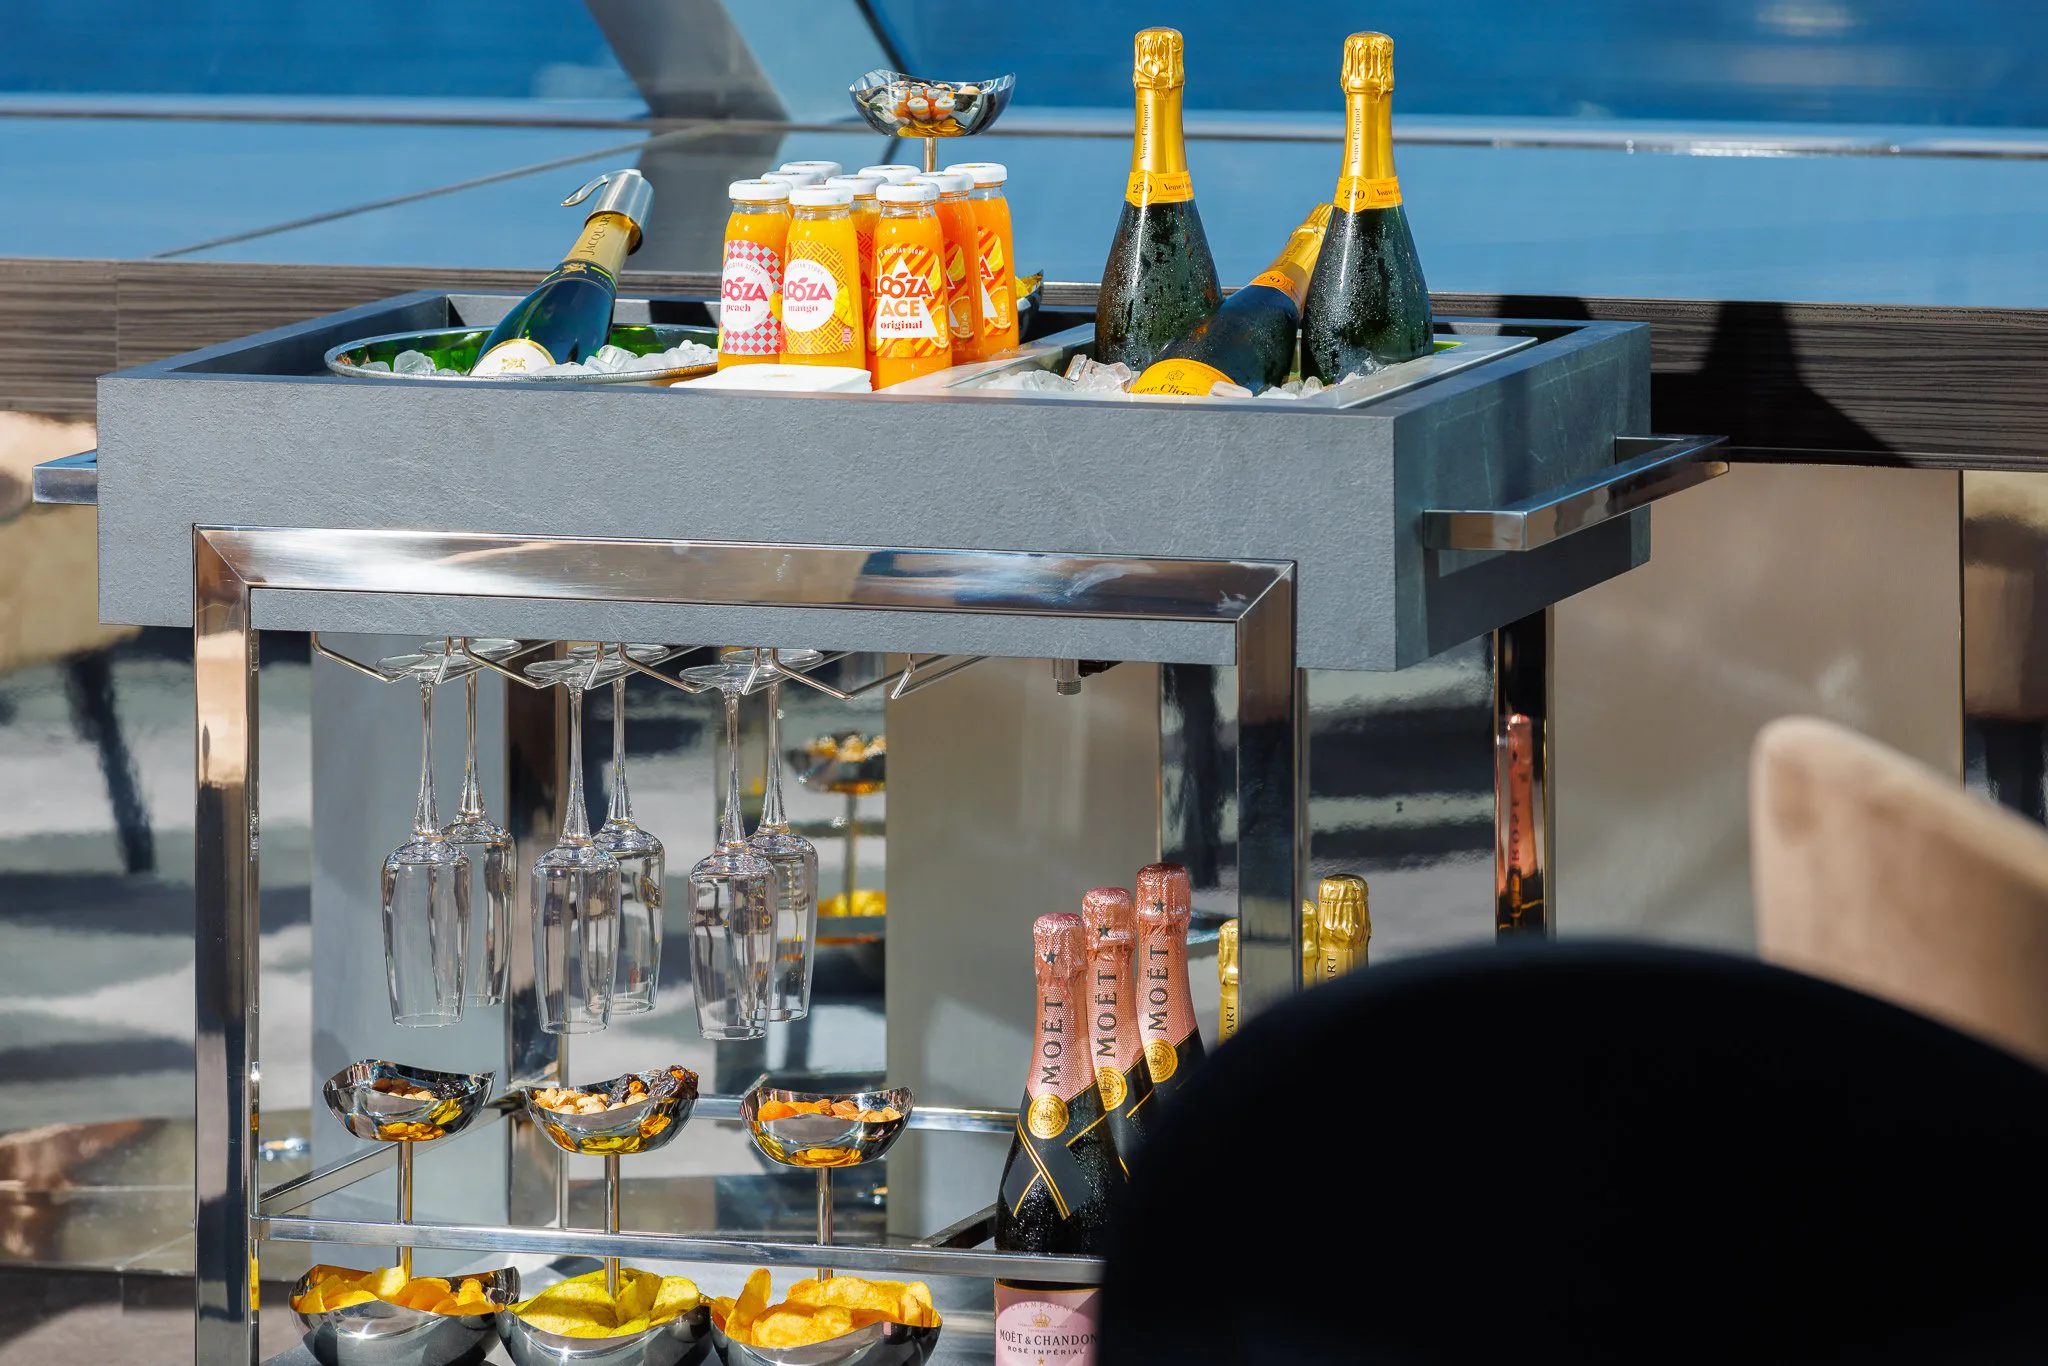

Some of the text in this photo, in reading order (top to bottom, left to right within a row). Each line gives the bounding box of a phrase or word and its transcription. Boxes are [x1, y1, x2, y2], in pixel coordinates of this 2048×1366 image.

[1141, 104, 1150, 136] Clicquot
[726, 304, 751, 313] peach
[788, 305, 819, 313] mango
[880, 300, 920, 317] ACE
[880, 320, 923, 331] original
[1149, 945, 1169, 1032] MOËT
[1096, 969, 1117, 1059] MOËT
[1041, 996, 1064, 1086] MOËT
[1000, 1329, 1097, 1346] MOËT & CHANDON
[1007, 1345, 1085, 1356] ROSÉ IMPÉRIAL
